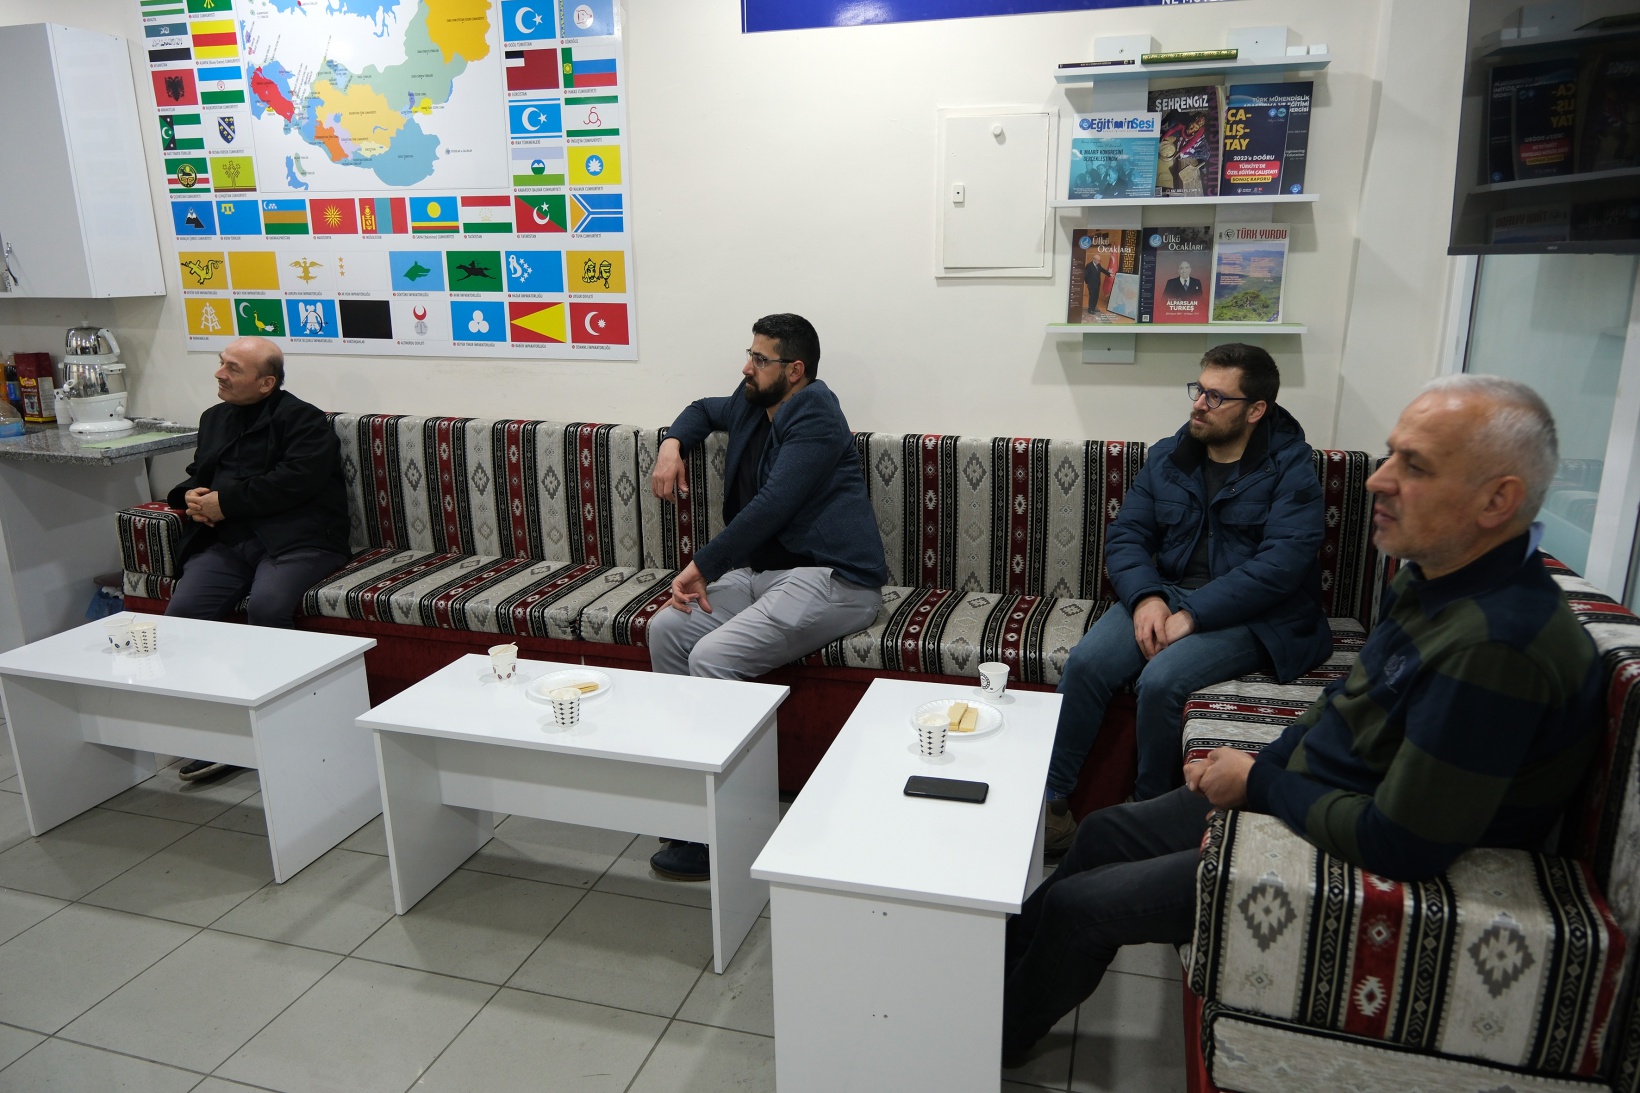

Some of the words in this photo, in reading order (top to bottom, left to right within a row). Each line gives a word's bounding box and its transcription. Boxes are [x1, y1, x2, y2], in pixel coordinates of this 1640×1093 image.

[1227, 109, 1252, 124] ÇA-
[1225, 124, 1250, 139] LIŞ-
[1224, 139, 1250, 150] TAY
[1162, 233, 1180, 242] Ülkü
[1236, 228, 1258, 239] TÜRK
[1259, 229, 1288, 239] YURDU
[1092, 236, 1110, 246] Ülkü
